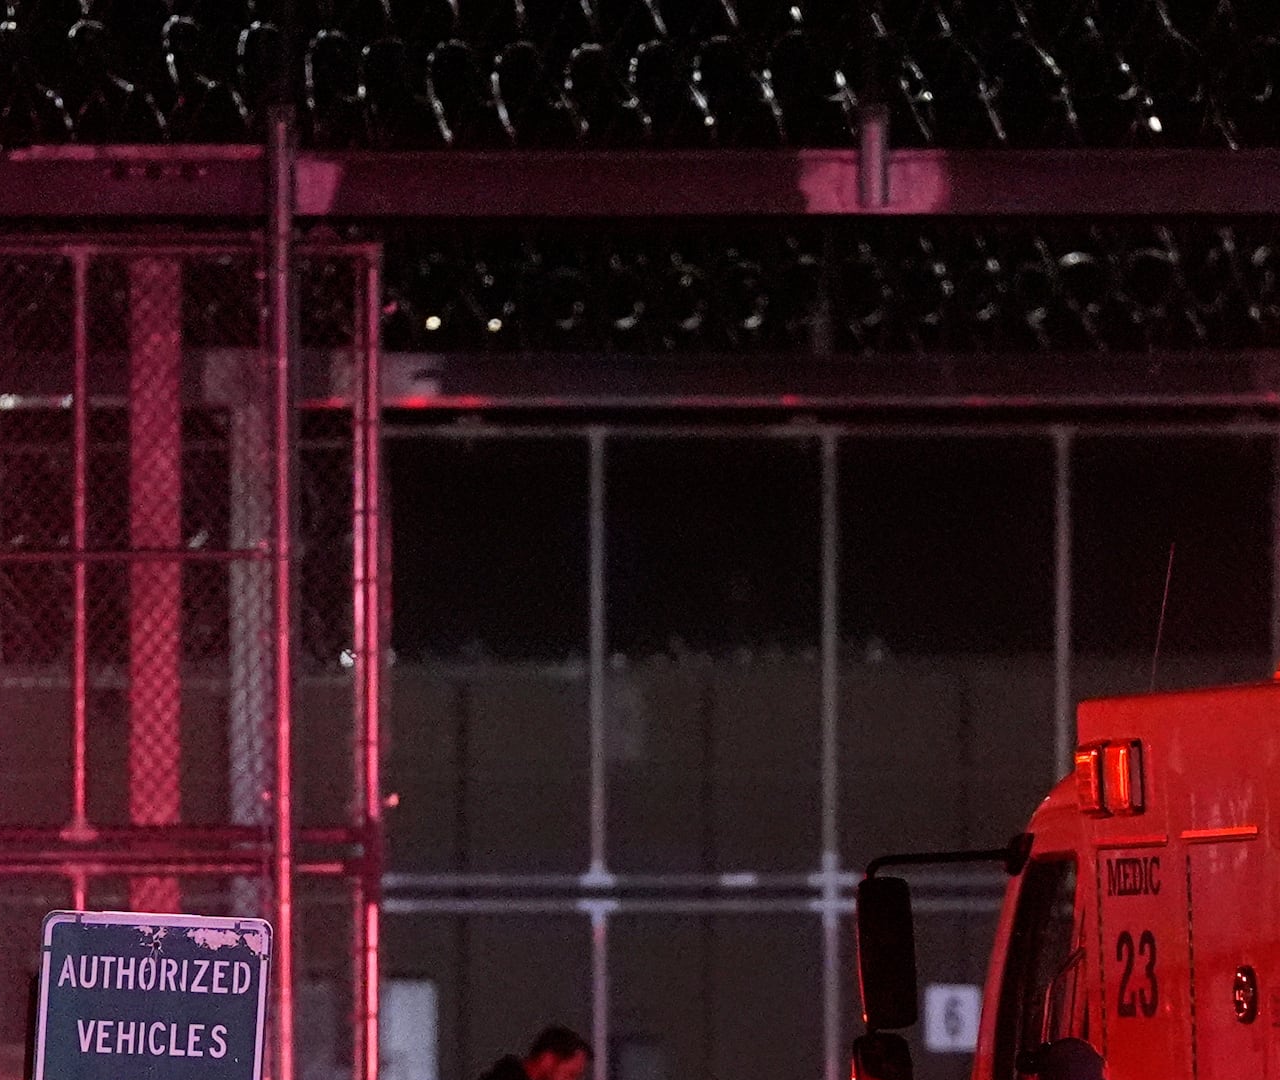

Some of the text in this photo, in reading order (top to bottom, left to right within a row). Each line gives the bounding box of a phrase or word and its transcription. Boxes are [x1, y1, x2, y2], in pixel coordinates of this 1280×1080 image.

[1106, 856, 1161, 897] MEDIC
[57, 954, 252, 995] AUTHORIZED
[1116, 930, 1159, 1018] 23
[77, 1019, 228, 1059] VEHICLES
